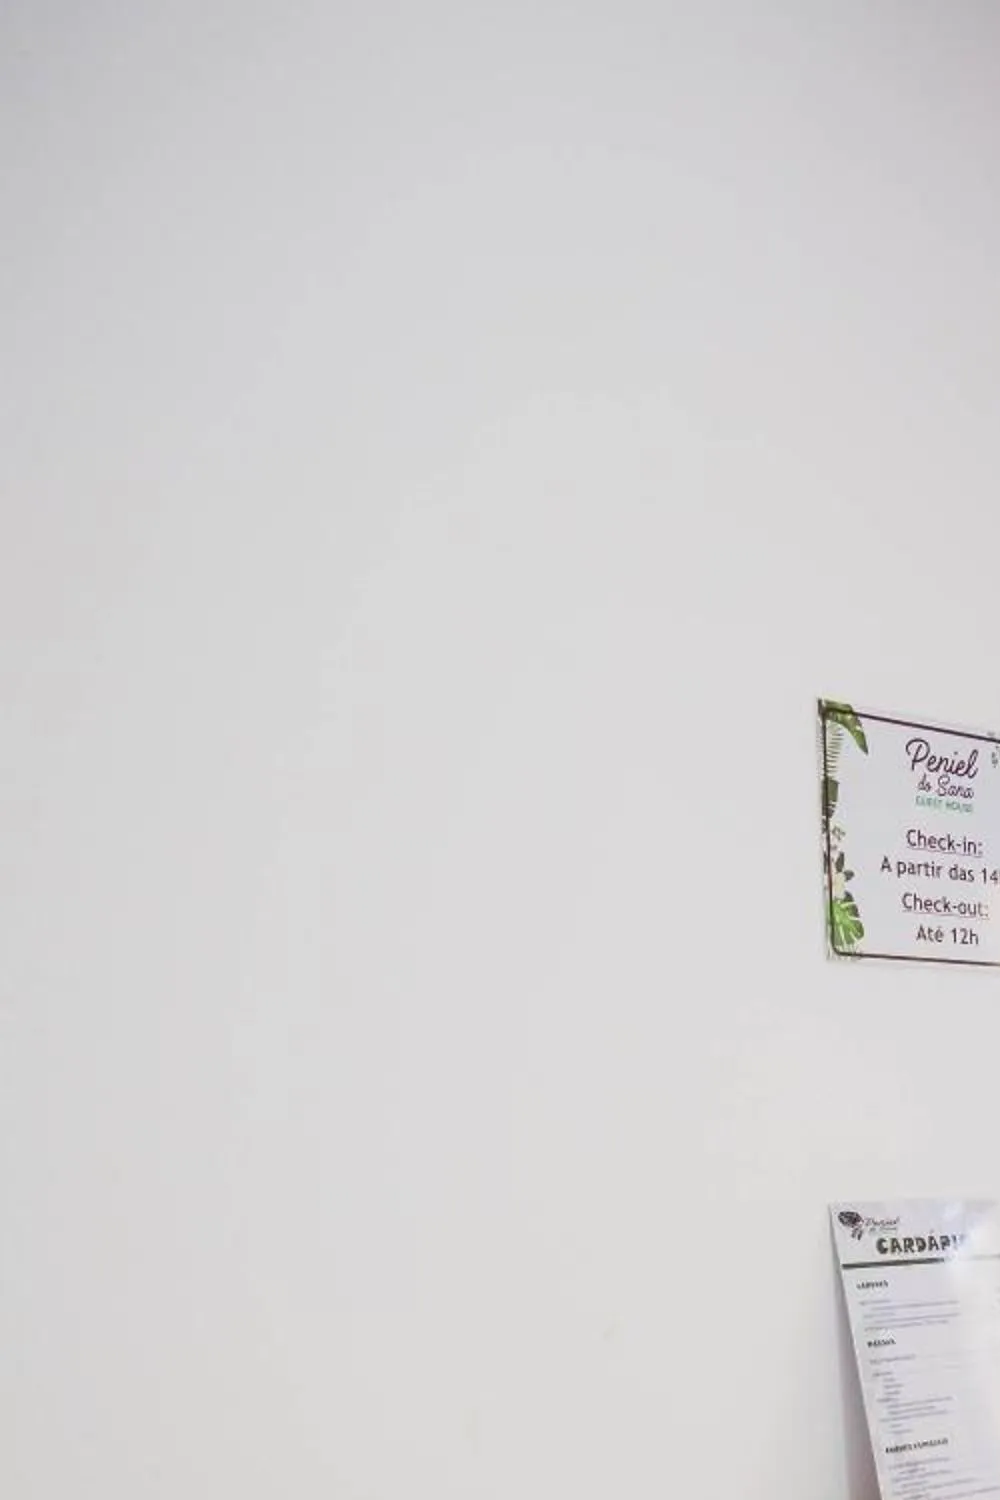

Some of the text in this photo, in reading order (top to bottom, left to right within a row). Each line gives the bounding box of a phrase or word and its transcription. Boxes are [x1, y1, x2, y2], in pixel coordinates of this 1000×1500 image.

[905, 737, 979, 778] Peniel
[917, 772, 975, 799] do Sana
[906, 828, 983, 857] Check-in:
[880, 855, 893, 873] A
[897, 859, 943, 879] partir
[948, 863, 975, 883] das
[901, 891, 989, 918] Check-out:
[916, 923, 979, 946] Até 12h
